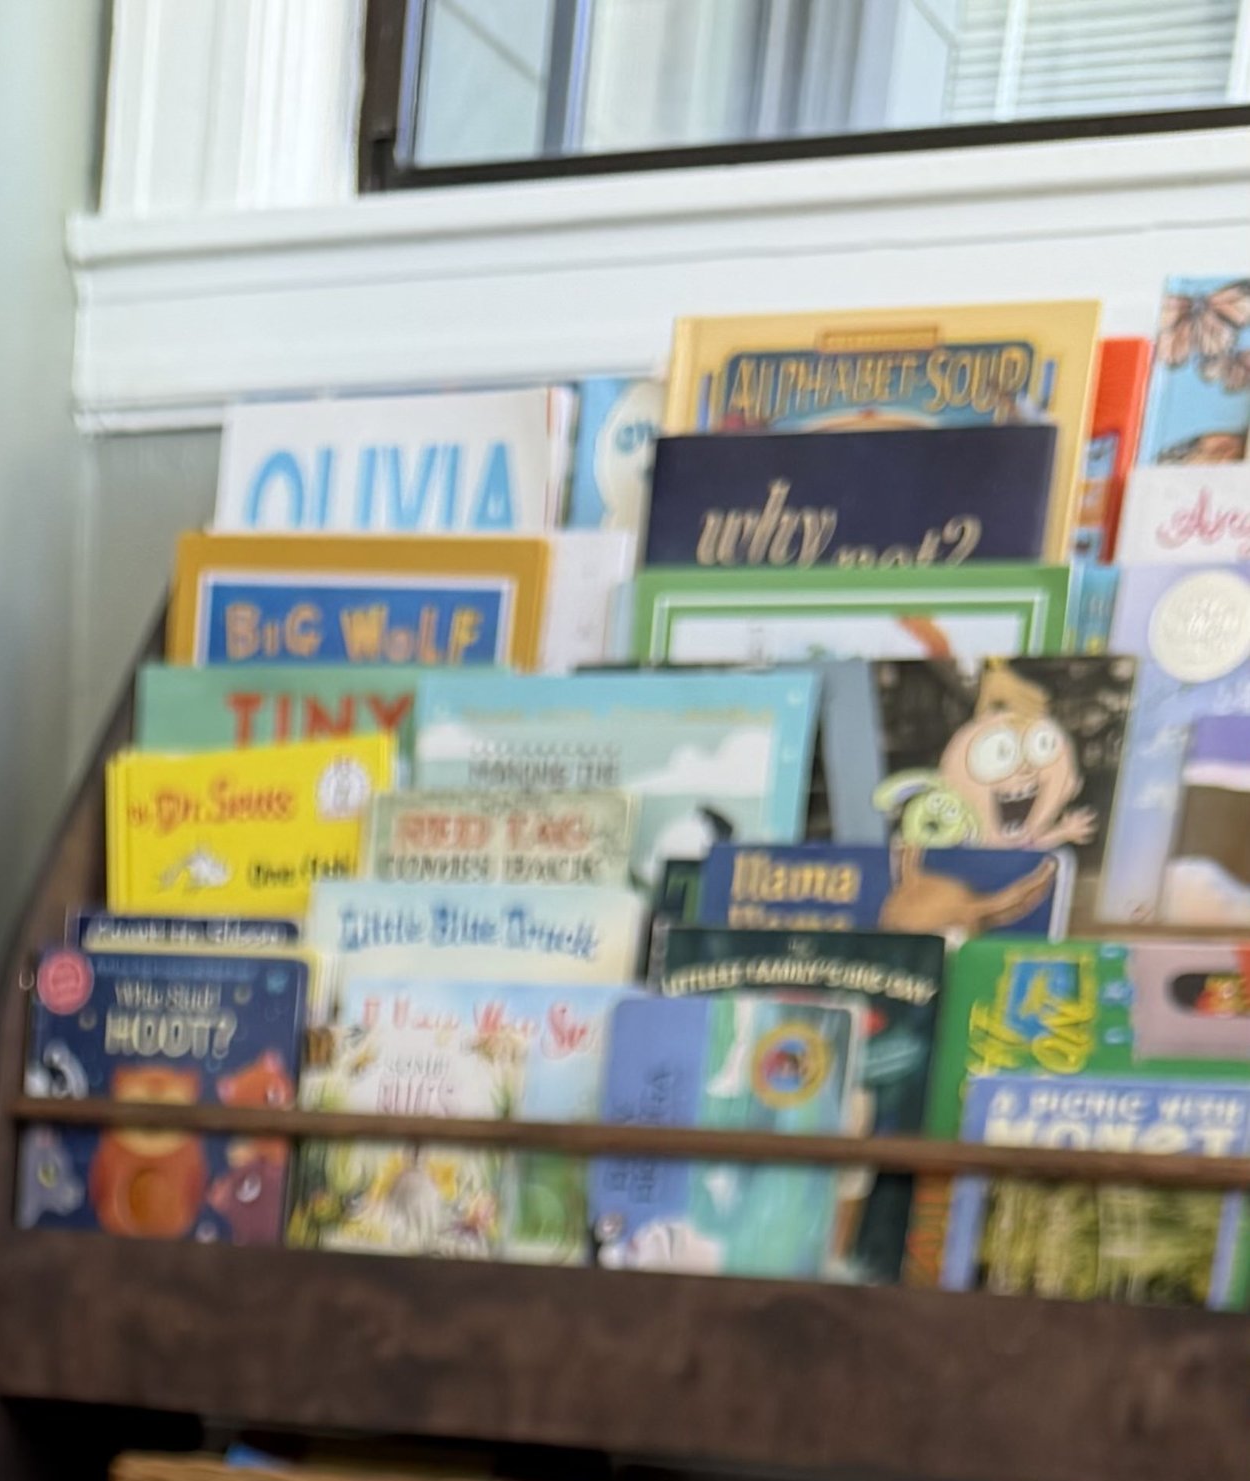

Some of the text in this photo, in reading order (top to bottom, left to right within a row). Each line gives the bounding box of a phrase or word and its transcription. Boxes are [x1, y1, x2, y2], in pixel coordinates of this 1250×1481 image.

[727, 344, 1031, 424] ALPHABET SOUP
[246, 441, 517, 529] OLIVIA
[696, 477, 837, 568] why
[224, 693, 413, 751] TINY
[104, 1007, 237, 1060] HOOT?
